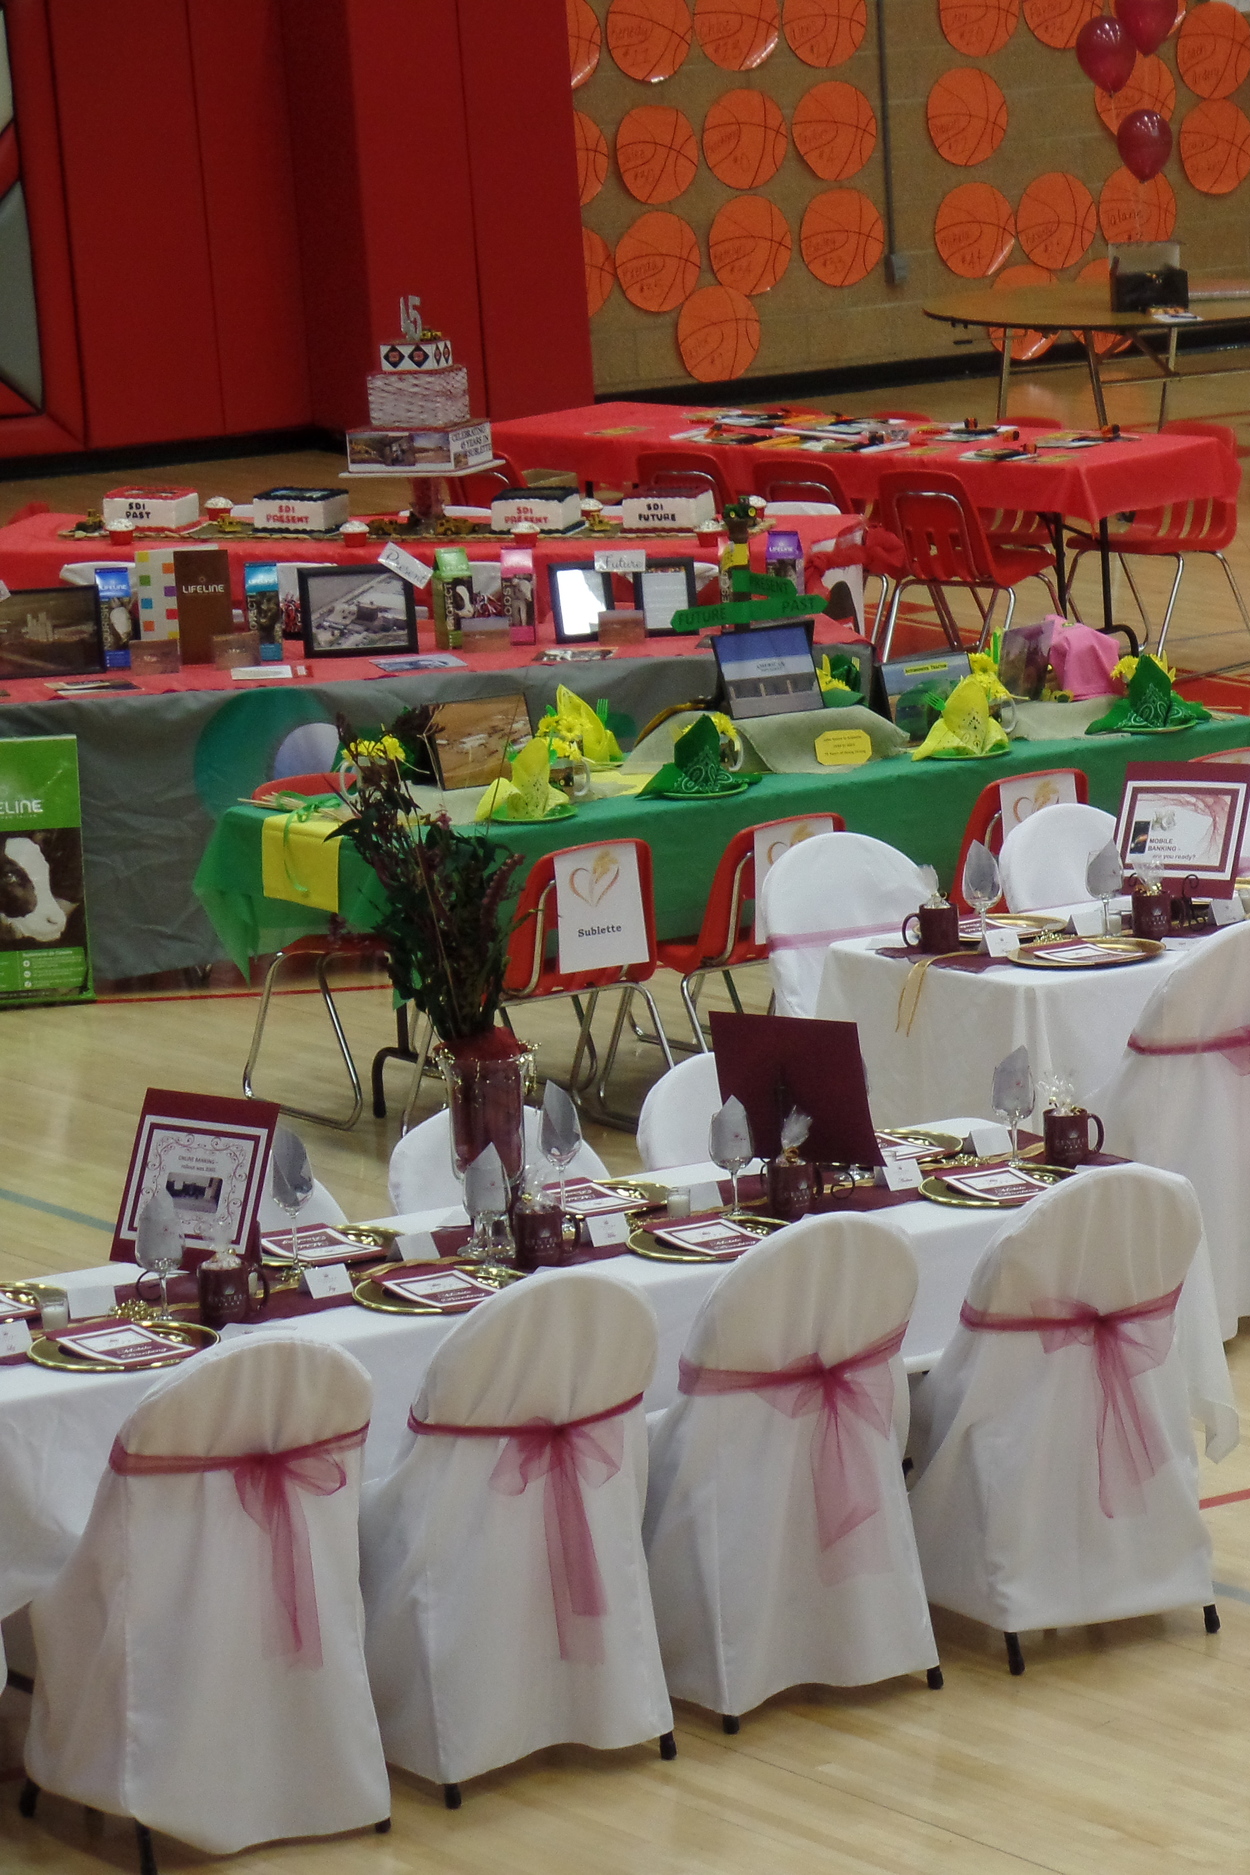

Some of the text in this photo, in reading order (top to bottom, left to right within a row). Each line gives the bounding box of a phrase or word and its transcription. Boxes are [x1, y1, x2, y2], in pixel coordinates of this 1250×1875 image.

[128, 502, 146, 510] SDI
[278, 505, 295, 513] SDI
[516, 506, 533, 514] SDI
[646, 503, 663, 511] SDI
[125, 511, 151, 519] PAST
[266, 514, 310, 524] PRESENT
[504, 514, 549, 524] PRESENT
[638, 513, 676, 522] FUTURE
[602, 555, 643, 571] Future
[182, 584, 225, 594] LIFELINE
[781, 598, 815, 612] PAST
[678, 608, 727, 626] FUTURE
[577, 924, 622, 938] Sublette
